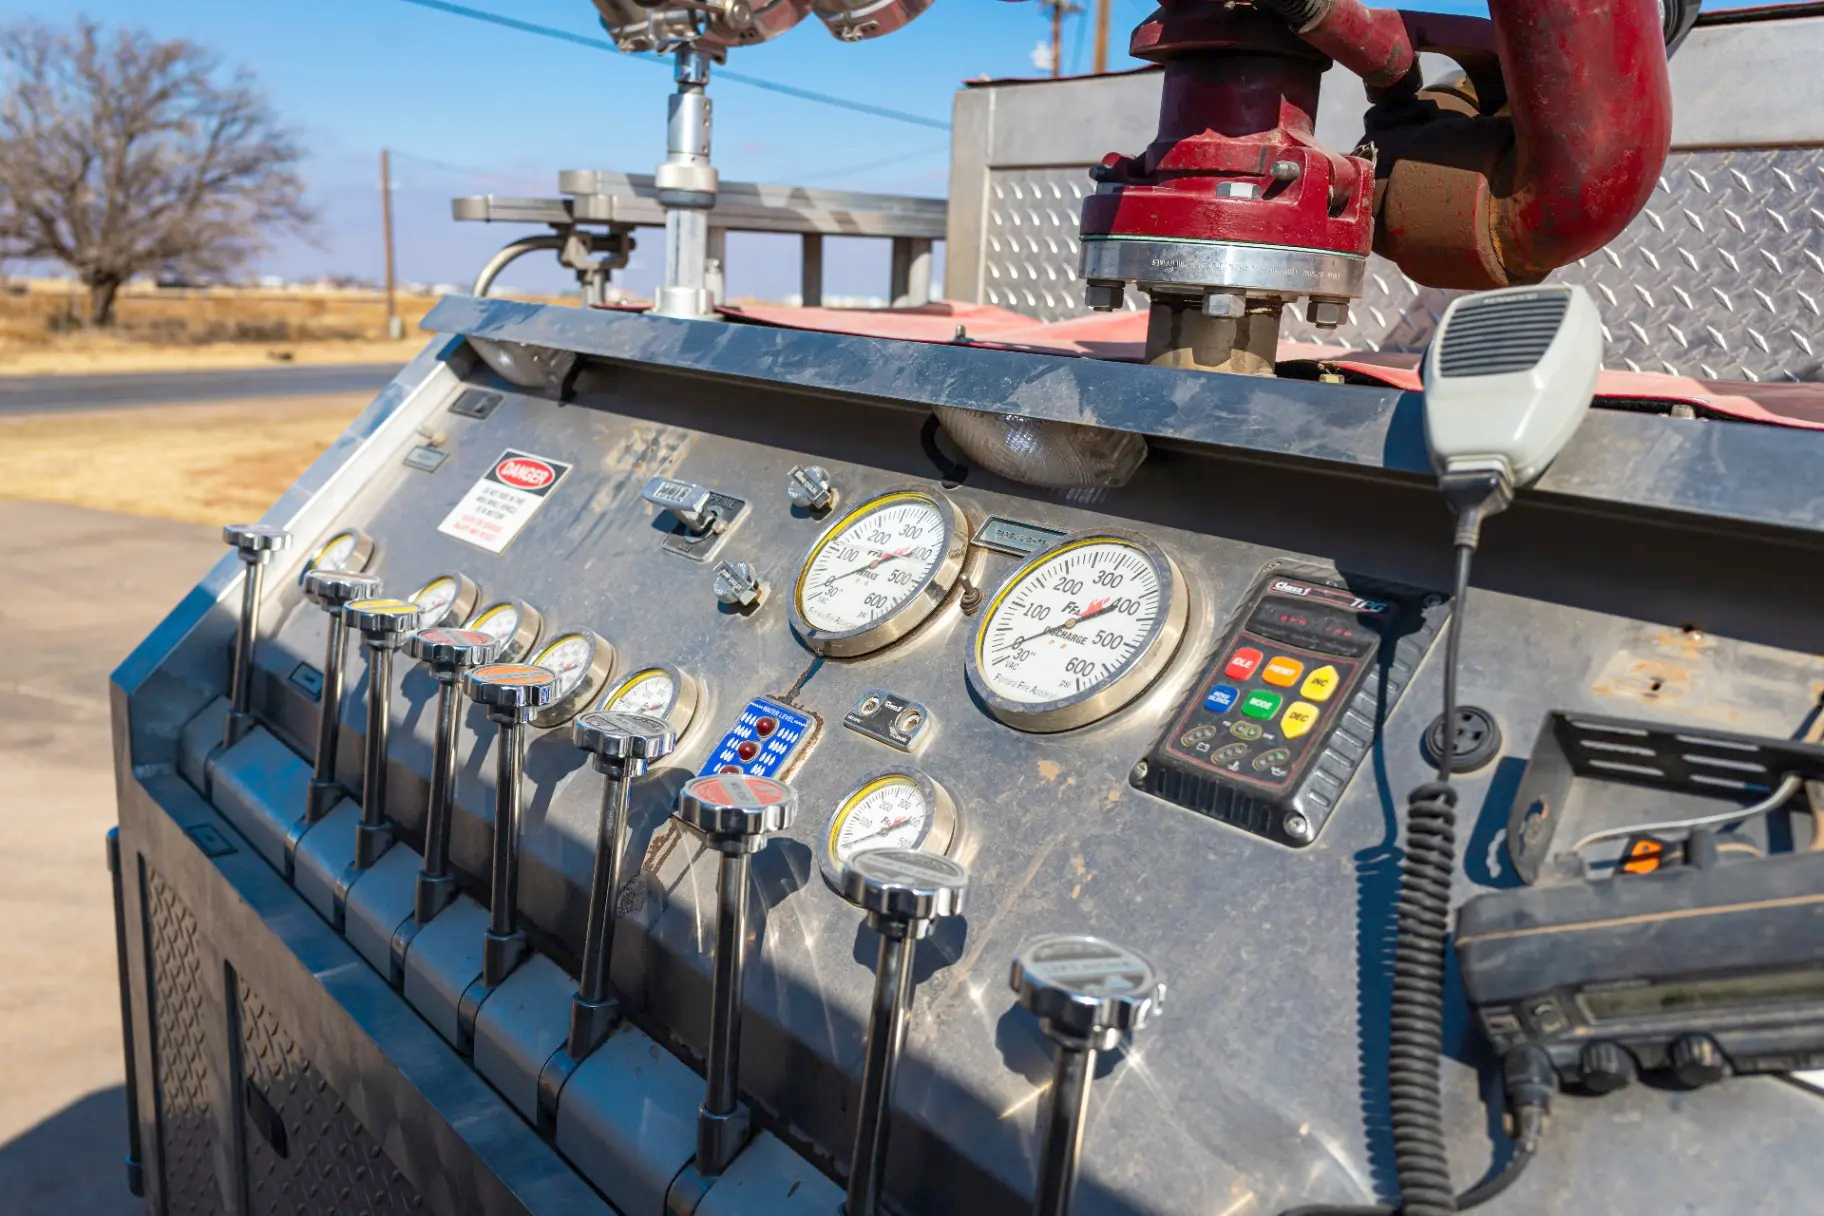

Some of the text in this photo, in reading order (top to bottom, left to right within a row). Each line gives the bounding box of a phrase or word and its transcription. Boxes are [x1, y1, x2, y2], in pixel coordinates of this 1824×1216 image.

[501, 461, 549, 485] DANGER
[709, 493, 736, 509] PRIME
[867, 530, 891, 545] 200
[898, 524, 923, 539] 300
[837, 547, 859, 562] 100
[888, 569, 912, 585] 500
[1092, 570, 1123, 589] 300
[1053, 576, 1083, 595] 200
[864, 592, 888, 609] 600
[1109, 597, 1141, 616] 400
[1350, 598, 1388, 613] TPG
[1023, 602, 1051, 621] 100
[1011, 635, 1025, 650] 0
[1043, 625, 1088, 646] DISCHARGE
[1092, 629, 1124, 650] 500
[1004, 659, 1019, 671] VAC
[1065, 657, 1095, 677] 600
[1231, 656, 1253, 669] IDLE
[1017, 681, 1031, 692] Fire
[1058, 679, 1072, 689] psi
[1310, 677, 1328, 687] INC
[1248, 697, 1273, 710] MODE
[762, 705, 794, 723] WATER LEVEL
[1289, 711, 1309, 722] DEC
